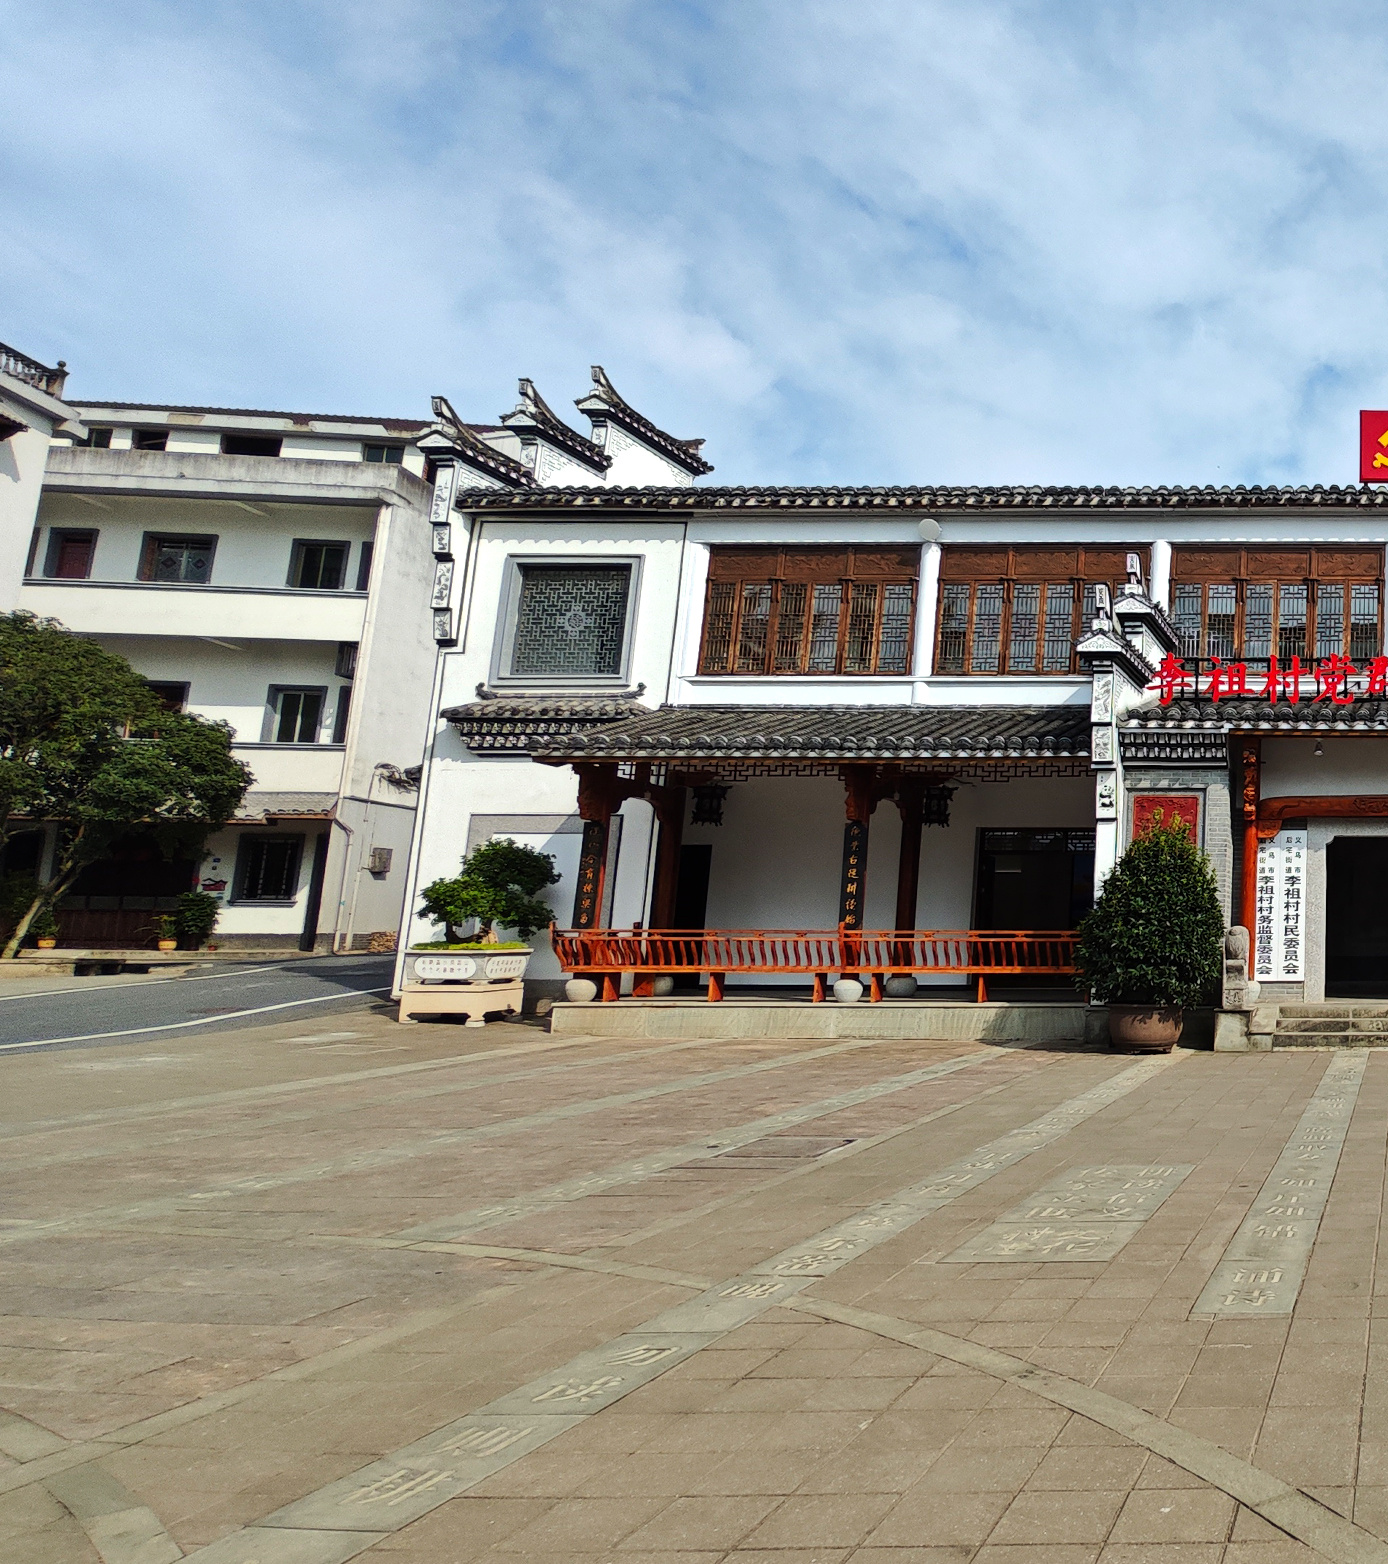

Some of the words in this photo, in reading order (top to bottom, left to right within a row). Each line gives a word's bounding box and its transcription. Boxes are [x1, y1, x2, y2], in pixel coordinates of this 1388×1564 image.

[1256, 875, 1275, 975] 李祖村村务监督委员会
[1282, 875, 1301, 975] 李祖村村民委员会
